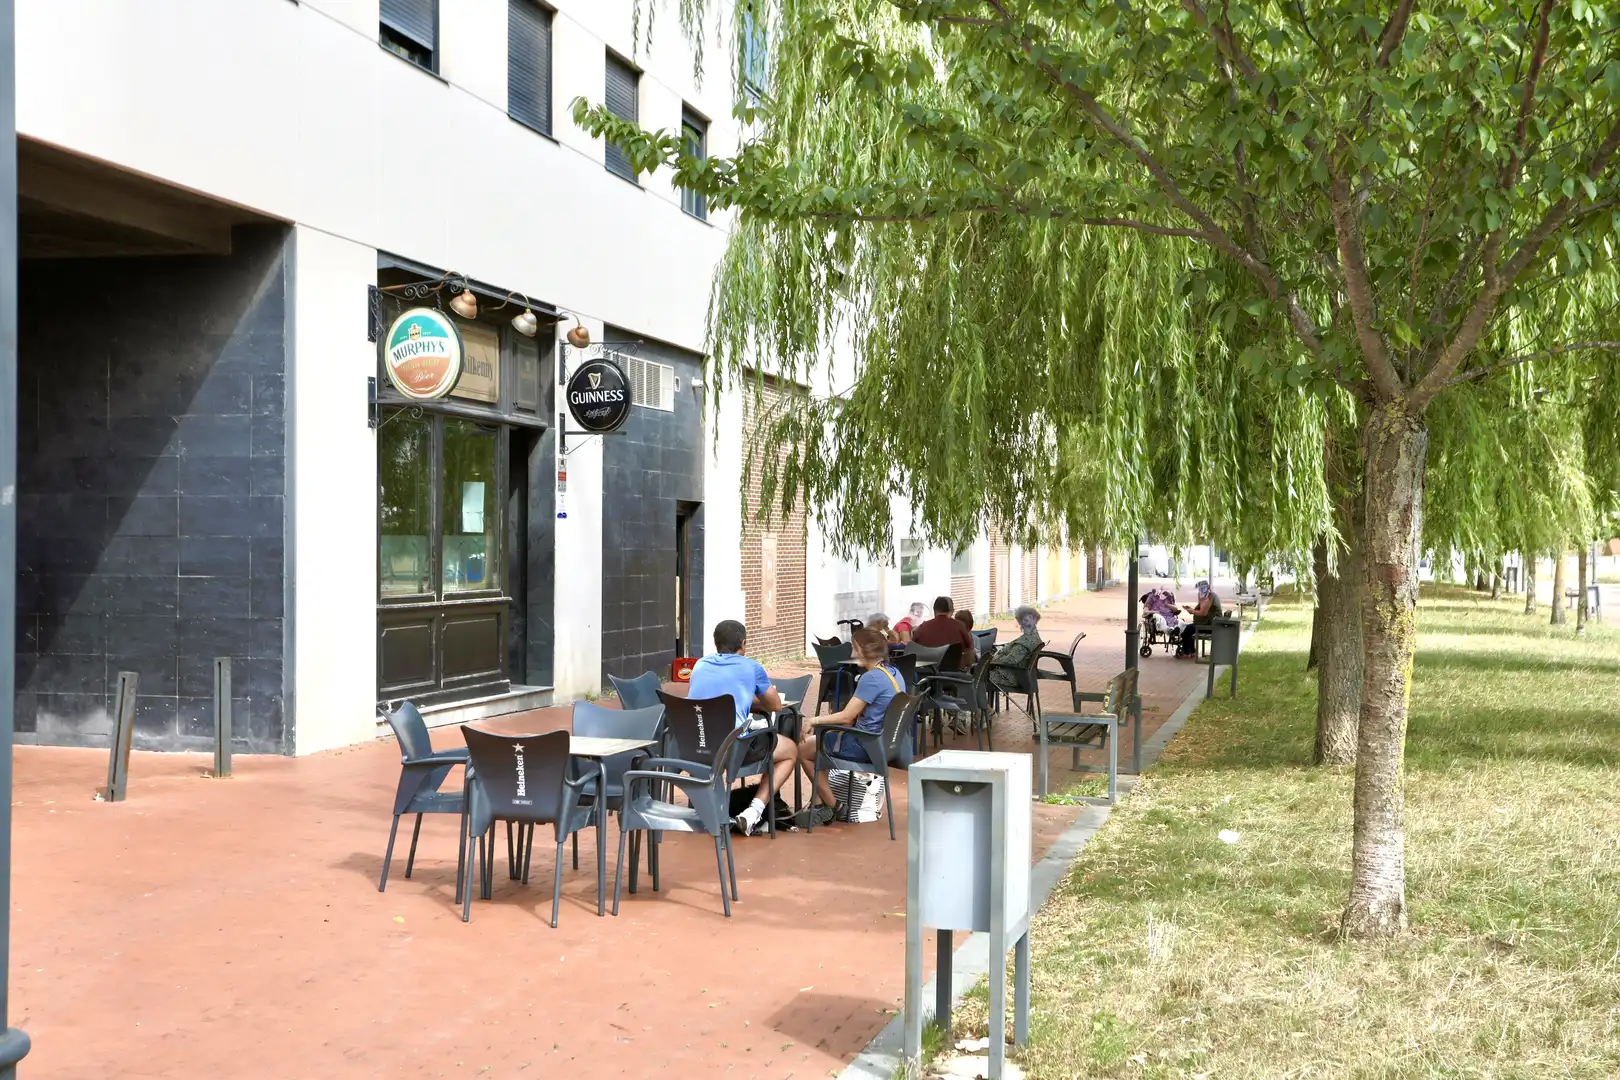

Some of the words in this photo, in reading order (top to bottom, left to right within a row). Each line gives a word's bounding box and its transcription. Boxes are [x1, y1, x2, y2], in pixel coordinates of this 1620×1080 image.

[392, 340, 445, 364] MURPHY'S
[570, 389, 624, 405] GUINNESS
[697, 713, 706, 748] Heineken
[516, 754, 526, 797] Heineken
